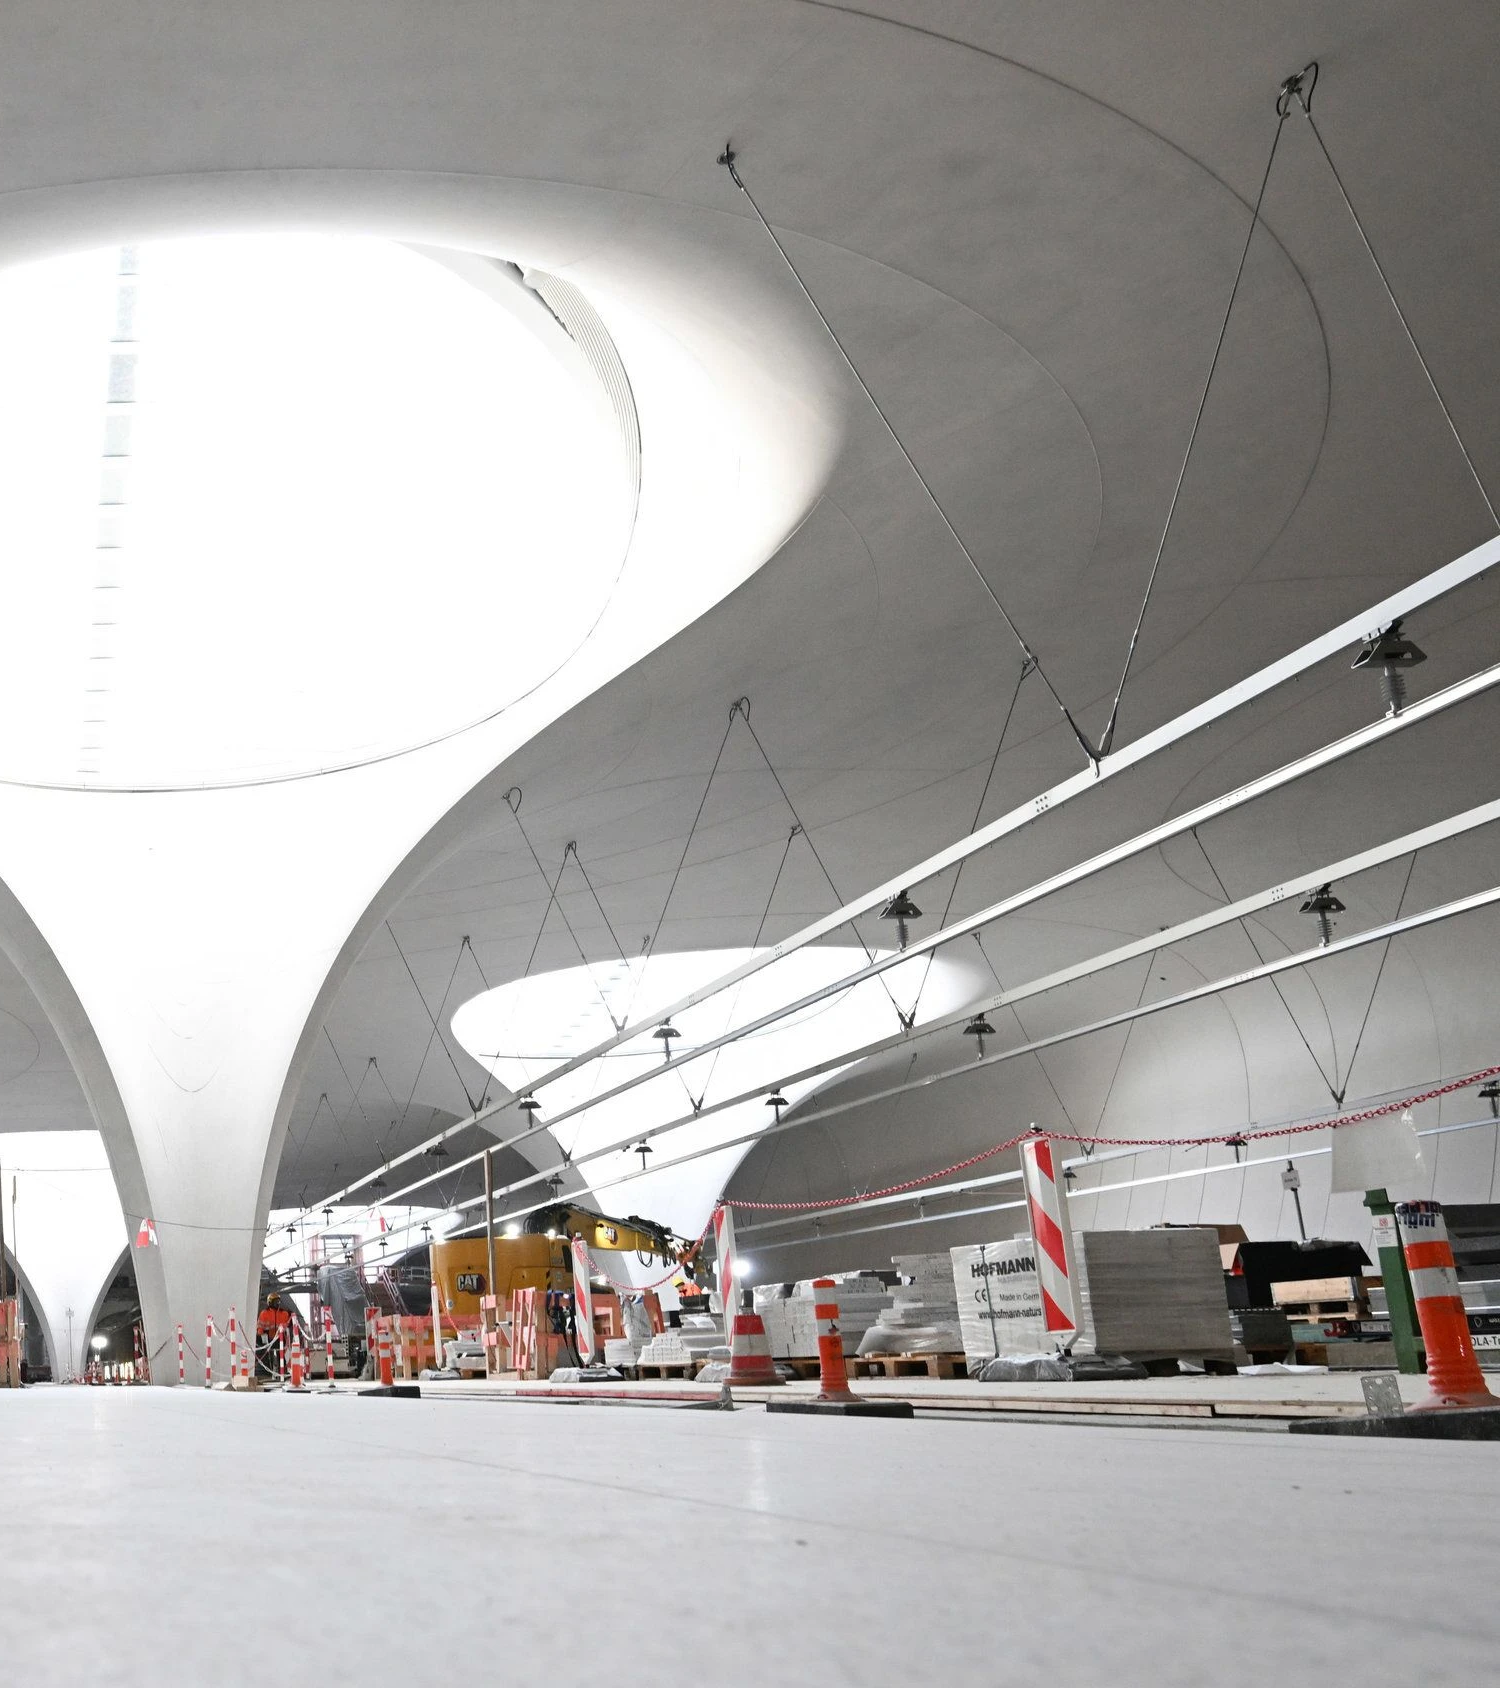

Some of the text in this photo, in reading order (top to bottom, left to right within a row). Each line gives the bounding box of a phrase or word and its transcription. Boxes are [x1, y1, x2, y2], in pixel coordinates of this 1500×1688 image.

[971, 1257, 1036, 1278] HOFMANN
[457, 1274, 479, 1291] CAT
[1000, 1293, 1016, 1301] Made
[978, 1307, 1042, 1319] wwwhofmann-naturs
